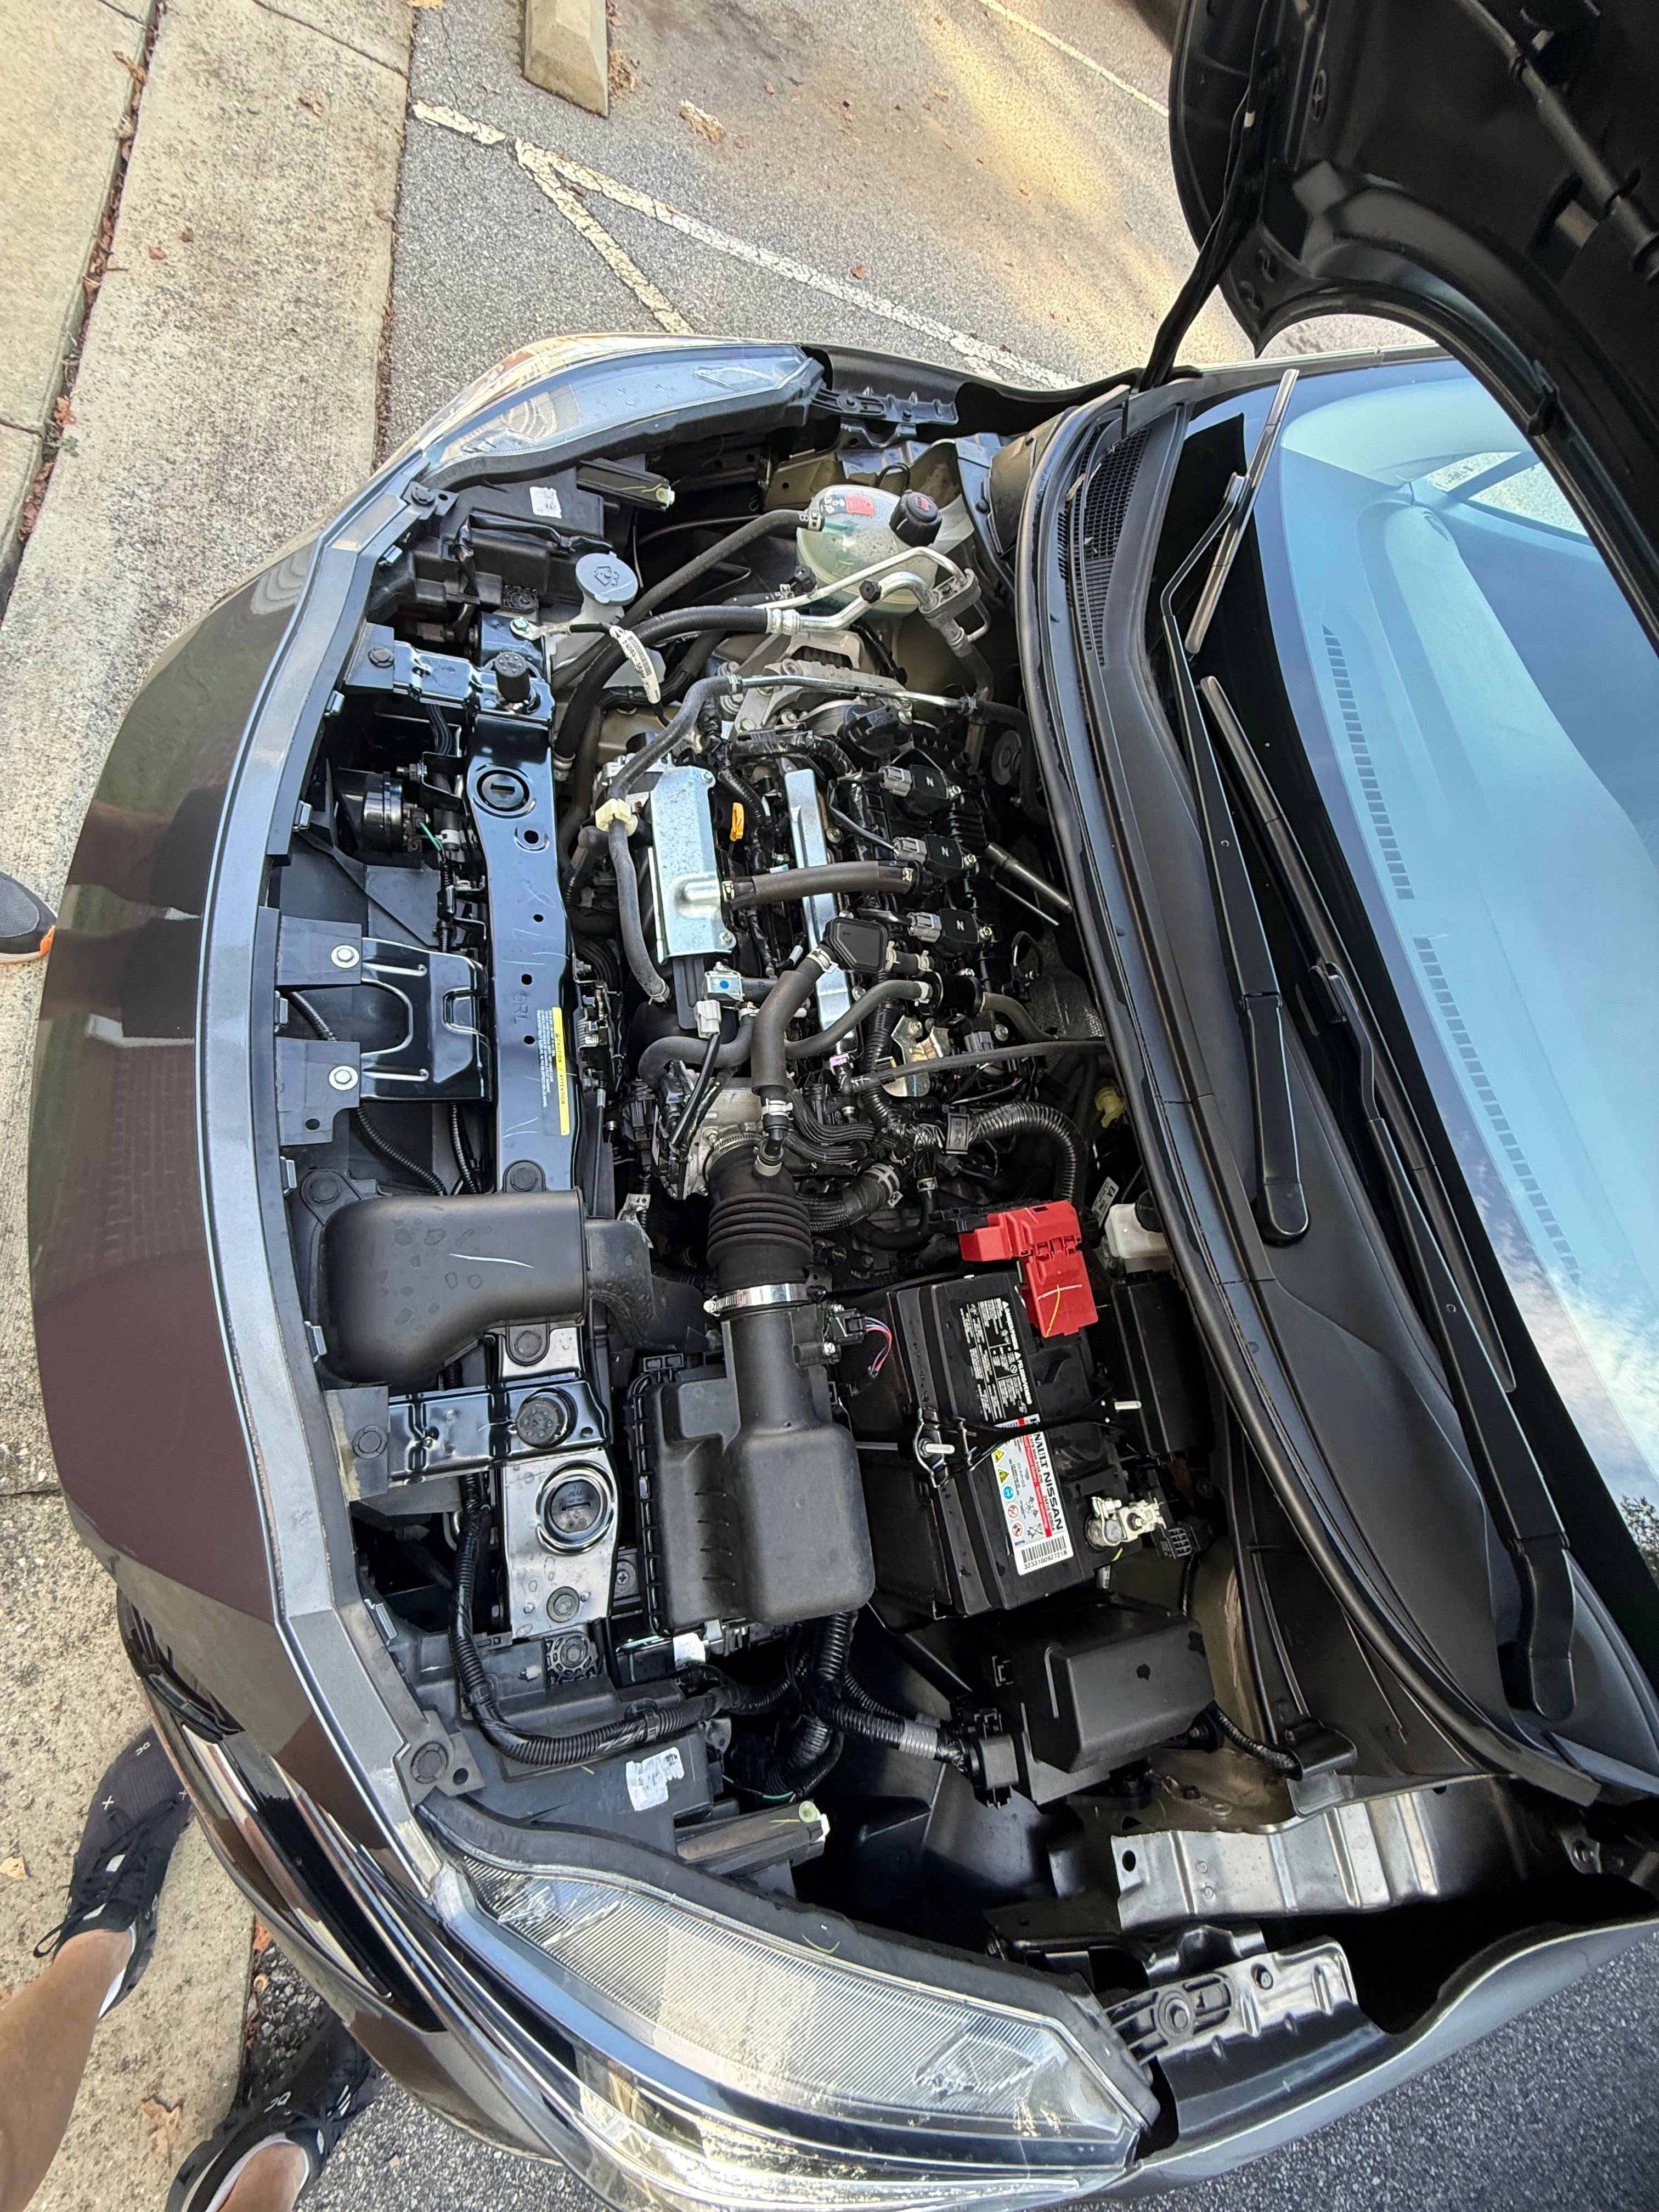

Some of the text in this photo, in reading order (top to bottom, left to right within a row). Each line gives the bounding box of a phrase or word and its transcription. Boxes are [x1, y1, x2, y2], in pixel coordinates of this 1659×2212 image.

[1005, 1307, 1032, 1405] DANGER/POISON PELIGRO/VENENO
[1017, 1463, 1026, 1488] CLARIOS
[1029, 1417, 1063, 1531] RNAULT NISSAN
